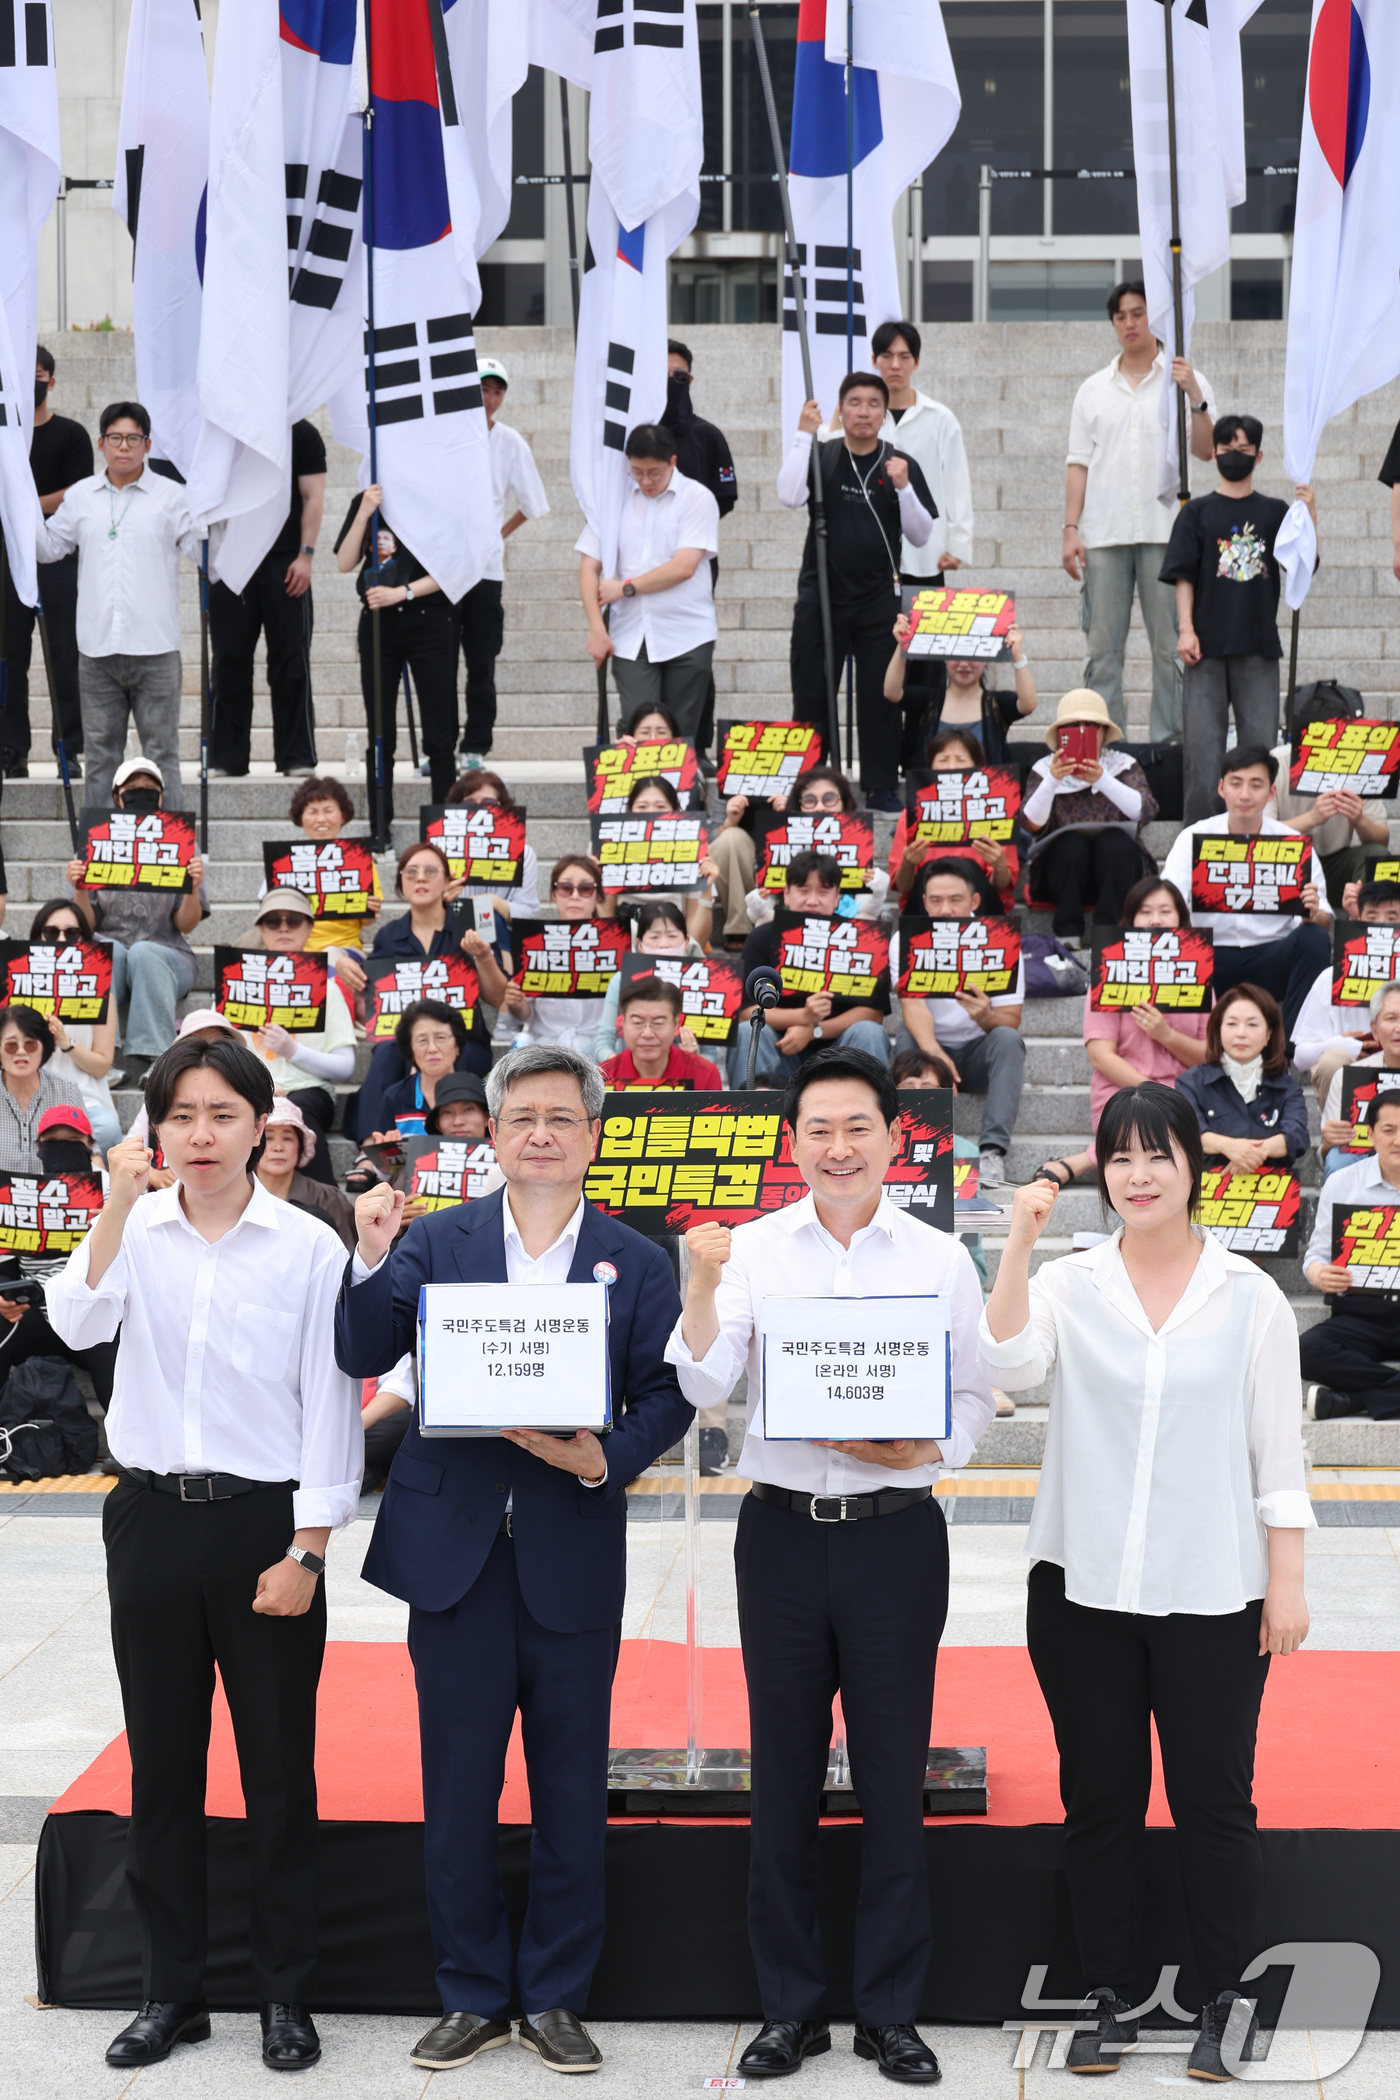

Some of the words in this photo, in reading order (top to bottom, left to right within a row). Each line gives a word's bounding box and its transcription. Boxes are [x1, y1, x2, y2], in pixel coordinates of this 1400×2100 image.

[912, 590, 947, 611] 한
[947, 592, 1008, 614] 표의
[915, 611, 998, 636] 권리를
[724, 724, 756, 750] 한
[755, 727, 815, 752] 표의
[1301, 721, 1337, 747] 한
[1336, 724, 1399, 751] 표의
[596, 748, 628, 775] 한
[630, 743, 688, 772] 표의
[1304, 746, 1387, 775] 권리를
[937, 771, 990, 800] 꼼수
[920, 800, 962, 821] 개헌
[966, 797, 1006, 821] 말고
[109, 813, 163, 842] 꼼수
[443, 809, 495, 837] 꼼수
[598, 820, 647, 842] 국민
[651, 820, 701, 841] 검열
[786, 816, 842, 844] 꼼수
[915, 822, 965, 842] 진짜
[92, 840, 134, 863] 개헌
[137, 842, 180, 865] 말고
[290, 843, 344, 872] 꼼수
[469, 836, 510, 859] 말고
[599, 840, 700, 864] 입틀막법
[84, 862, 135, 885] 진짜
[138, 865, 187, 887] 특검
[320, 869, 361, 893] 말고
[469, 859, 518, 881] 특검
[601, 862, 700, 887] 철회하라
[323, 891, 369, 914] 특검
[543, 923, 600, 951] 꼼수
[802, 917, 858, 951] 꼼수
[931, 921, 988, 950] 꼼수
[1123, 932, 1180, 961] 꼼수
[28, 945, 83, 974] 꼼수
[241, 953, 295, 984] 꼼수
[526, 949, 570, 971] 개헌
[574, 949, 617, 971] 말고
[784, 944, 826, 971] 개헌
[829, 950, 873, 975] 말고
[913, 948, 957, 971] 개헌
[962, 948, 1005, 971] 말고
[1105, 960, 1150, 983] 개헌
[1153, 960, 1197, 984] 말고
[1348, 954, 1391, 980] 개헌
[11, 973, 54, 996] 개헌
[58, 974, 98, 997] 말고
[394, 959, 449, 991] 꼼수
[521, 971, 573, 993] 진짜
[780, 967, 826, 993] 진짜
[828, 973, 878, 997] 특검
[906, 971, 960, 993] 진짜
[226, 979, 265, 1005] 개헌
[269, 984, 312, 1006] 말고
[682, 990, 725, 1016] 말고
[1099, 983, 1152, 1006] 진짜
[1155, 984, 1206, 1007] 특검
[58, 997, 104, 1019] 특검
[223, 1001, 267, 1028] 진짜
[270, 1006, 320, 1028] 특검
[600, 1115, 780, 1158] 입틀막법
[437, 1141, 498, 1174] 꼼수
[912, 1143, 935, 1163] 및
[9, 1176, 70, 1208] 꼼수
[417, 1171, 463, 1197] 개헌
[584, 1163, 762, 1207] 국민특검
[1222, 1173, 1292, 1202] 표의
[42, 1208, 89, 1231] 말고
[1344, 1210, 1384, 1238] 한
[442, 1318, 526, 1334] 국민주도특검
[533, 1318, 590, 1334] 서명운동
[781, 1341, 866, 1357] 국민주도특검
[873, 1341, 930, 1357] 서명운동
[487, 1362, 545, 1378] 12,159명
[827, 1385, 885, 1401] 14,603명
